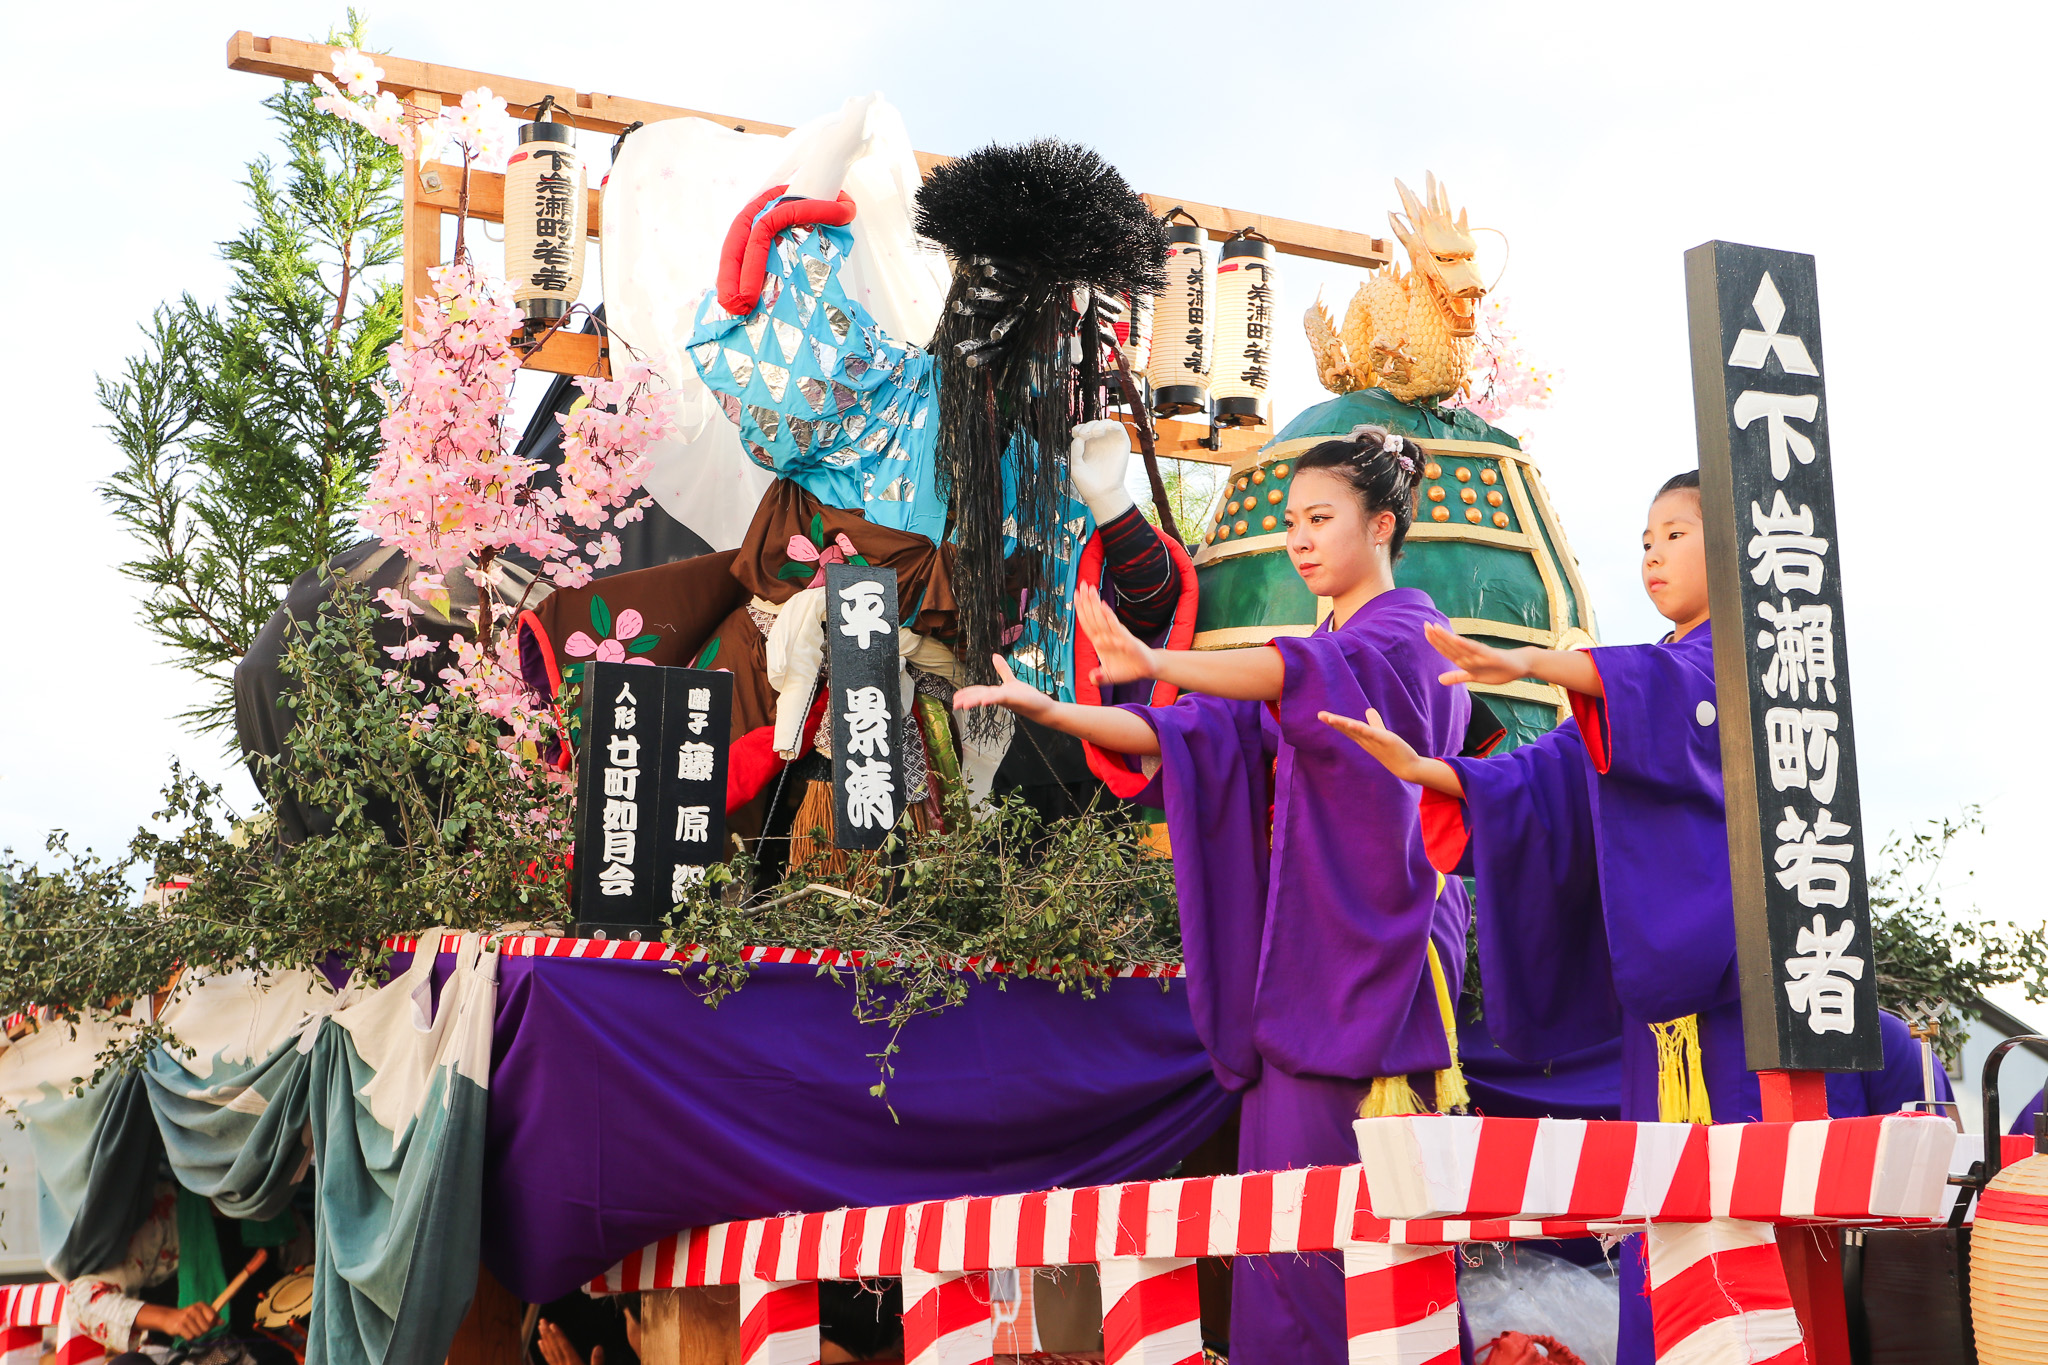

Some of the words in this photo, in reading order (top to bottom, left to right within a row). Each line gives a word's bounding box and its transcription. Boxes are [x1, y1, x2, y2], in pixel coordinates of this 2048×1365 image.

[839, 580, 894, 830] 平景清
[1733, 390, 1864, 1035] 下岩瀬町若者
